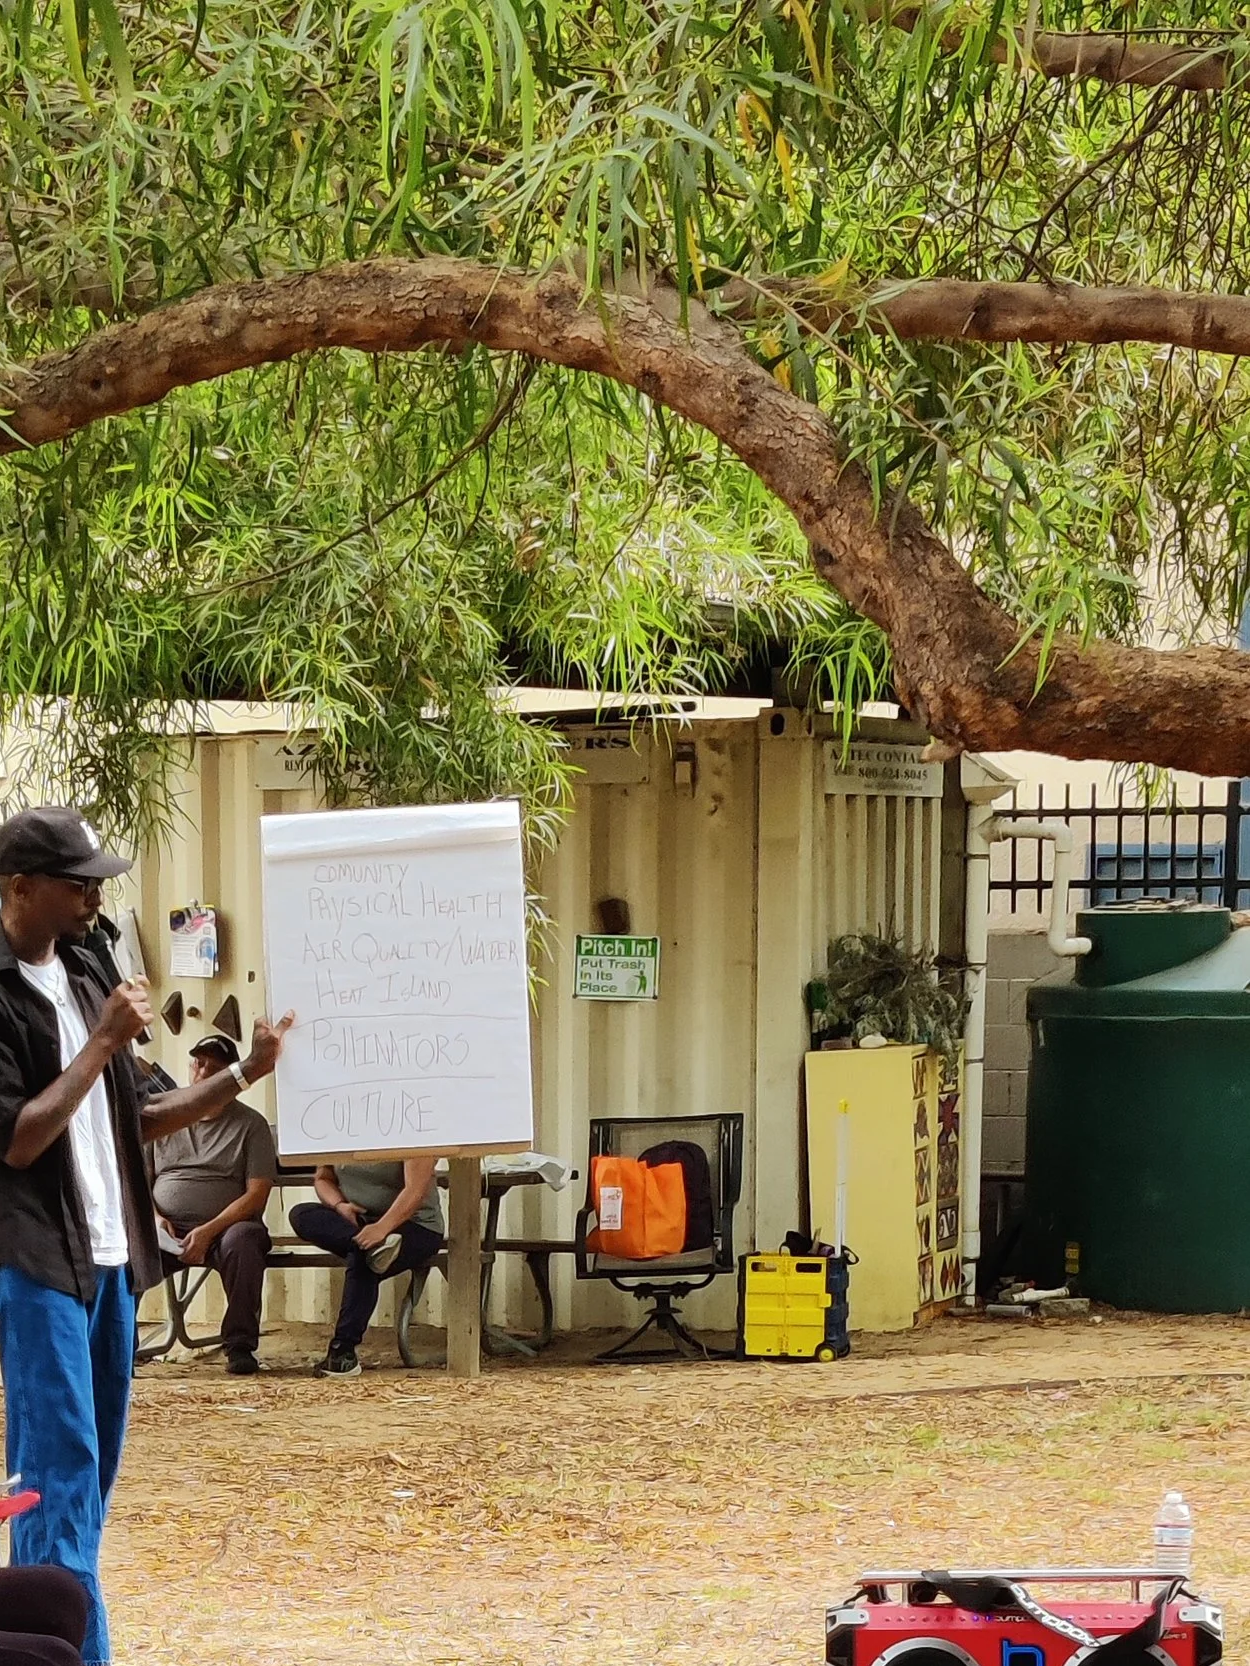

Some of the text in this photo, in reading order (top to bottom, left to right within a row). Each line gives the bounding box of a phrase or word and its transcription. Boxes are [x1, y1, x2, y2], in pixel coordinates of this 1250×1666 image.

[830, 748, 918, 764] ATEC CONTA
[313, 863, 409, 888] COMUNITY
[420, 881, 502, 920] HEALTH
[302, 932, 348, 964] AIR
[580, 939, 653, 956] Pitch In!
[580, 958, 646, 969] Put Trash
[596, 971, 613, 980] Its
[314, 968, 452, 1009] HEAT ISLAND
[579, 982, 618, 993] Place
[300, 1090, 439, 1141] CULTURE
